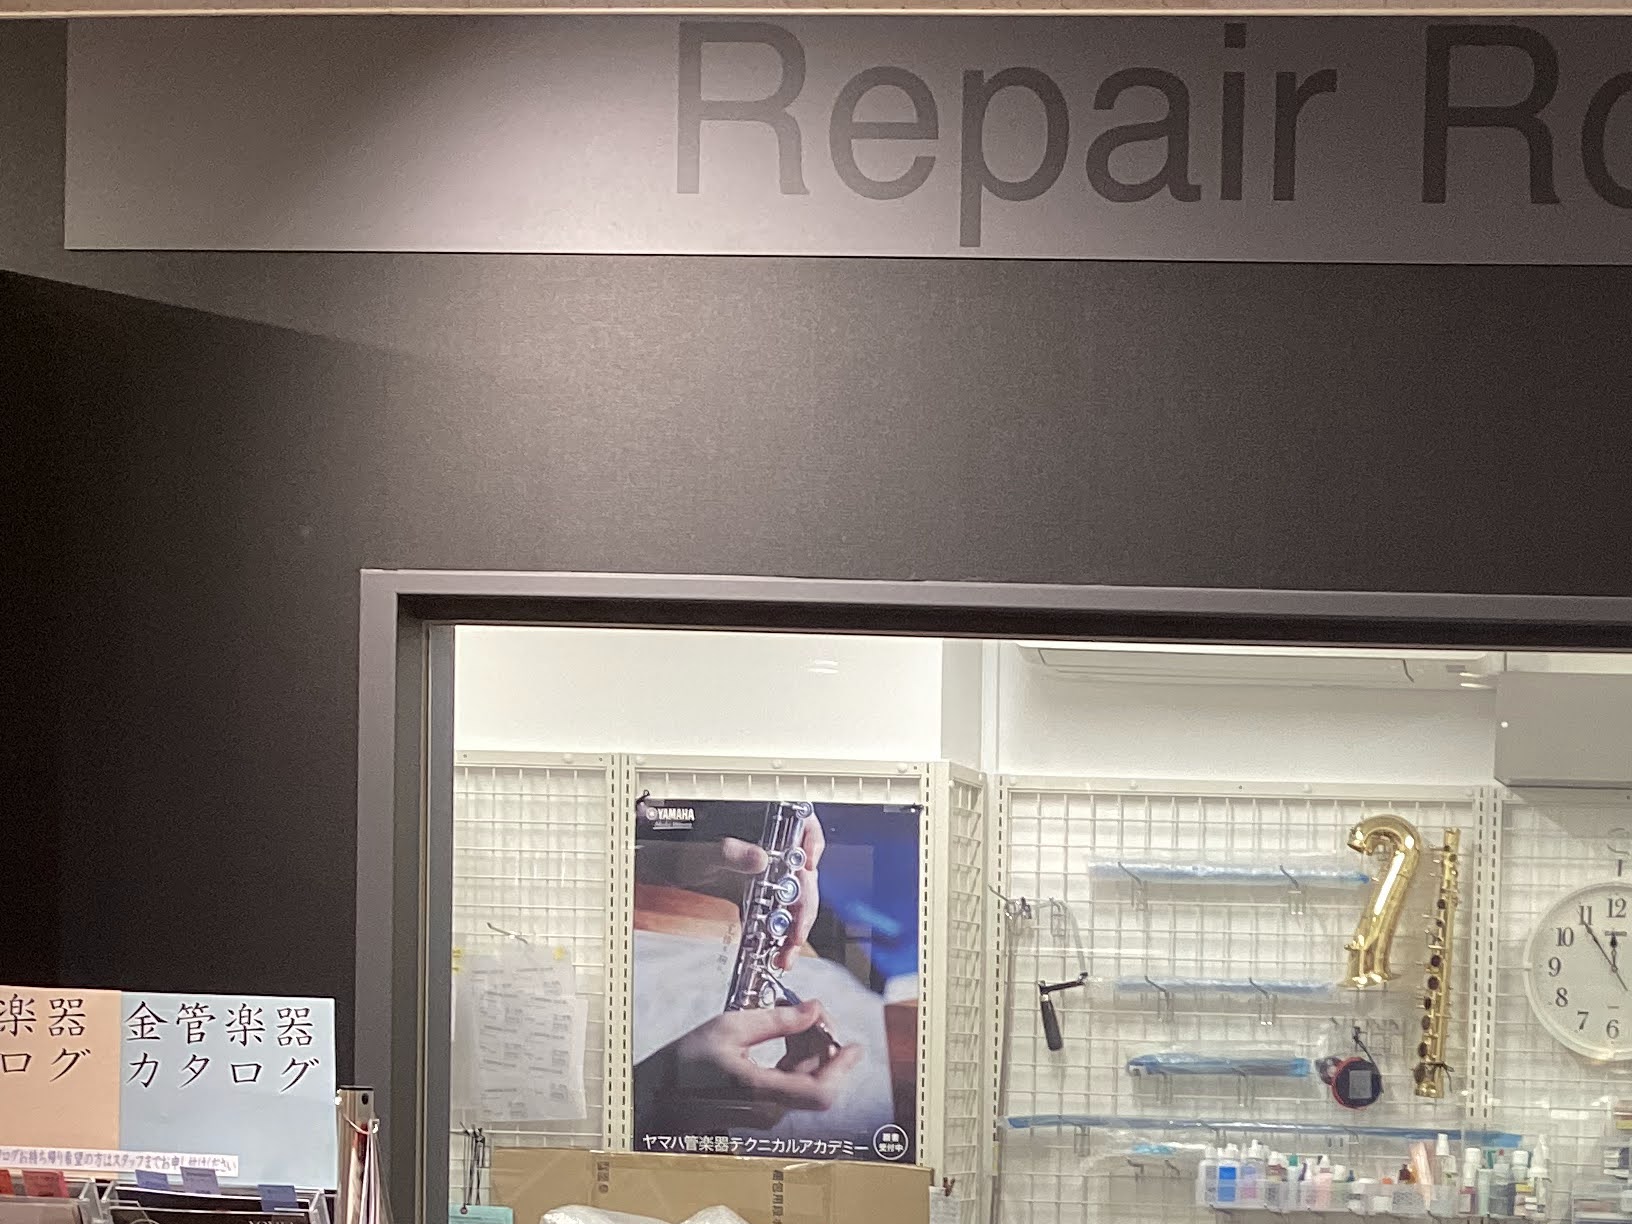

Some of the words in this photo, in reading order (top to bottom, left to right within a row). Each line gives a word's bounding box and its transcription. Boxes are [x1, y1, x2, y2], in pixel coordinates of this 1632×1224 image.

[674, 20, 1338, 248] Repair
[658, 808, 695, 821] YAMAHA
[1579, 905, 1593, 926] 11
[1607, 898, 1626, 918] 12
[1556, 928, 1574, 947] 10
[1548, 957, 1561, 977] 9
[1555, 987, 1568, 1007] 8
[0, 993, 87, 1037] 楽器
[124, 1001, 314, 1048] 金管楽器
[1577, 1011, 1589, 1031] 7
[1606, 1019, 1619, 1039] 6
[0, 1047, 92, 1082] ログ
[128, 1053, 320, 1093] カタログ
[642, 1133, 869, 1155] ヤマハ管楽器テクニカルアカデミー
